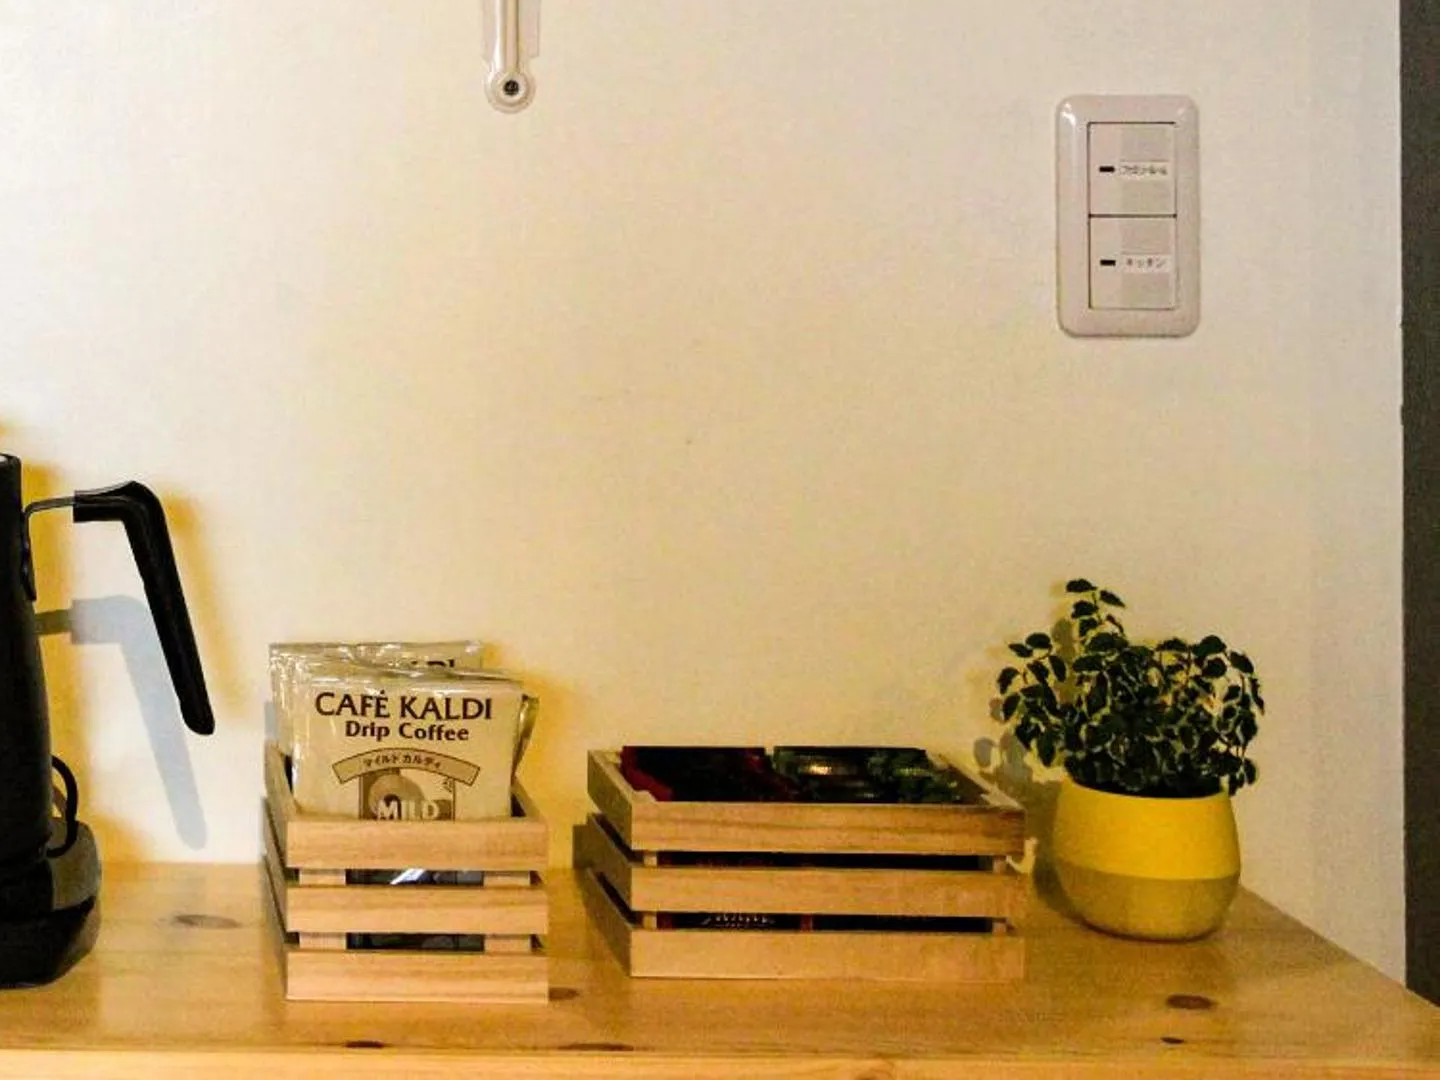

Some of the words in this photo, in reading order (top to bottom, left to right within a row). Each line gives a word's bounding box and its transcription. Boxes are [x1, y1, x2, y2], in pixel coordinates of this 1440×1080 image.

[315, 689, 390, 719] CAFÉ
[400, 695, 493, 720] KALDI
[345, 720, 390, 741] Drip
[398, 722, 469, 741] Coffee
